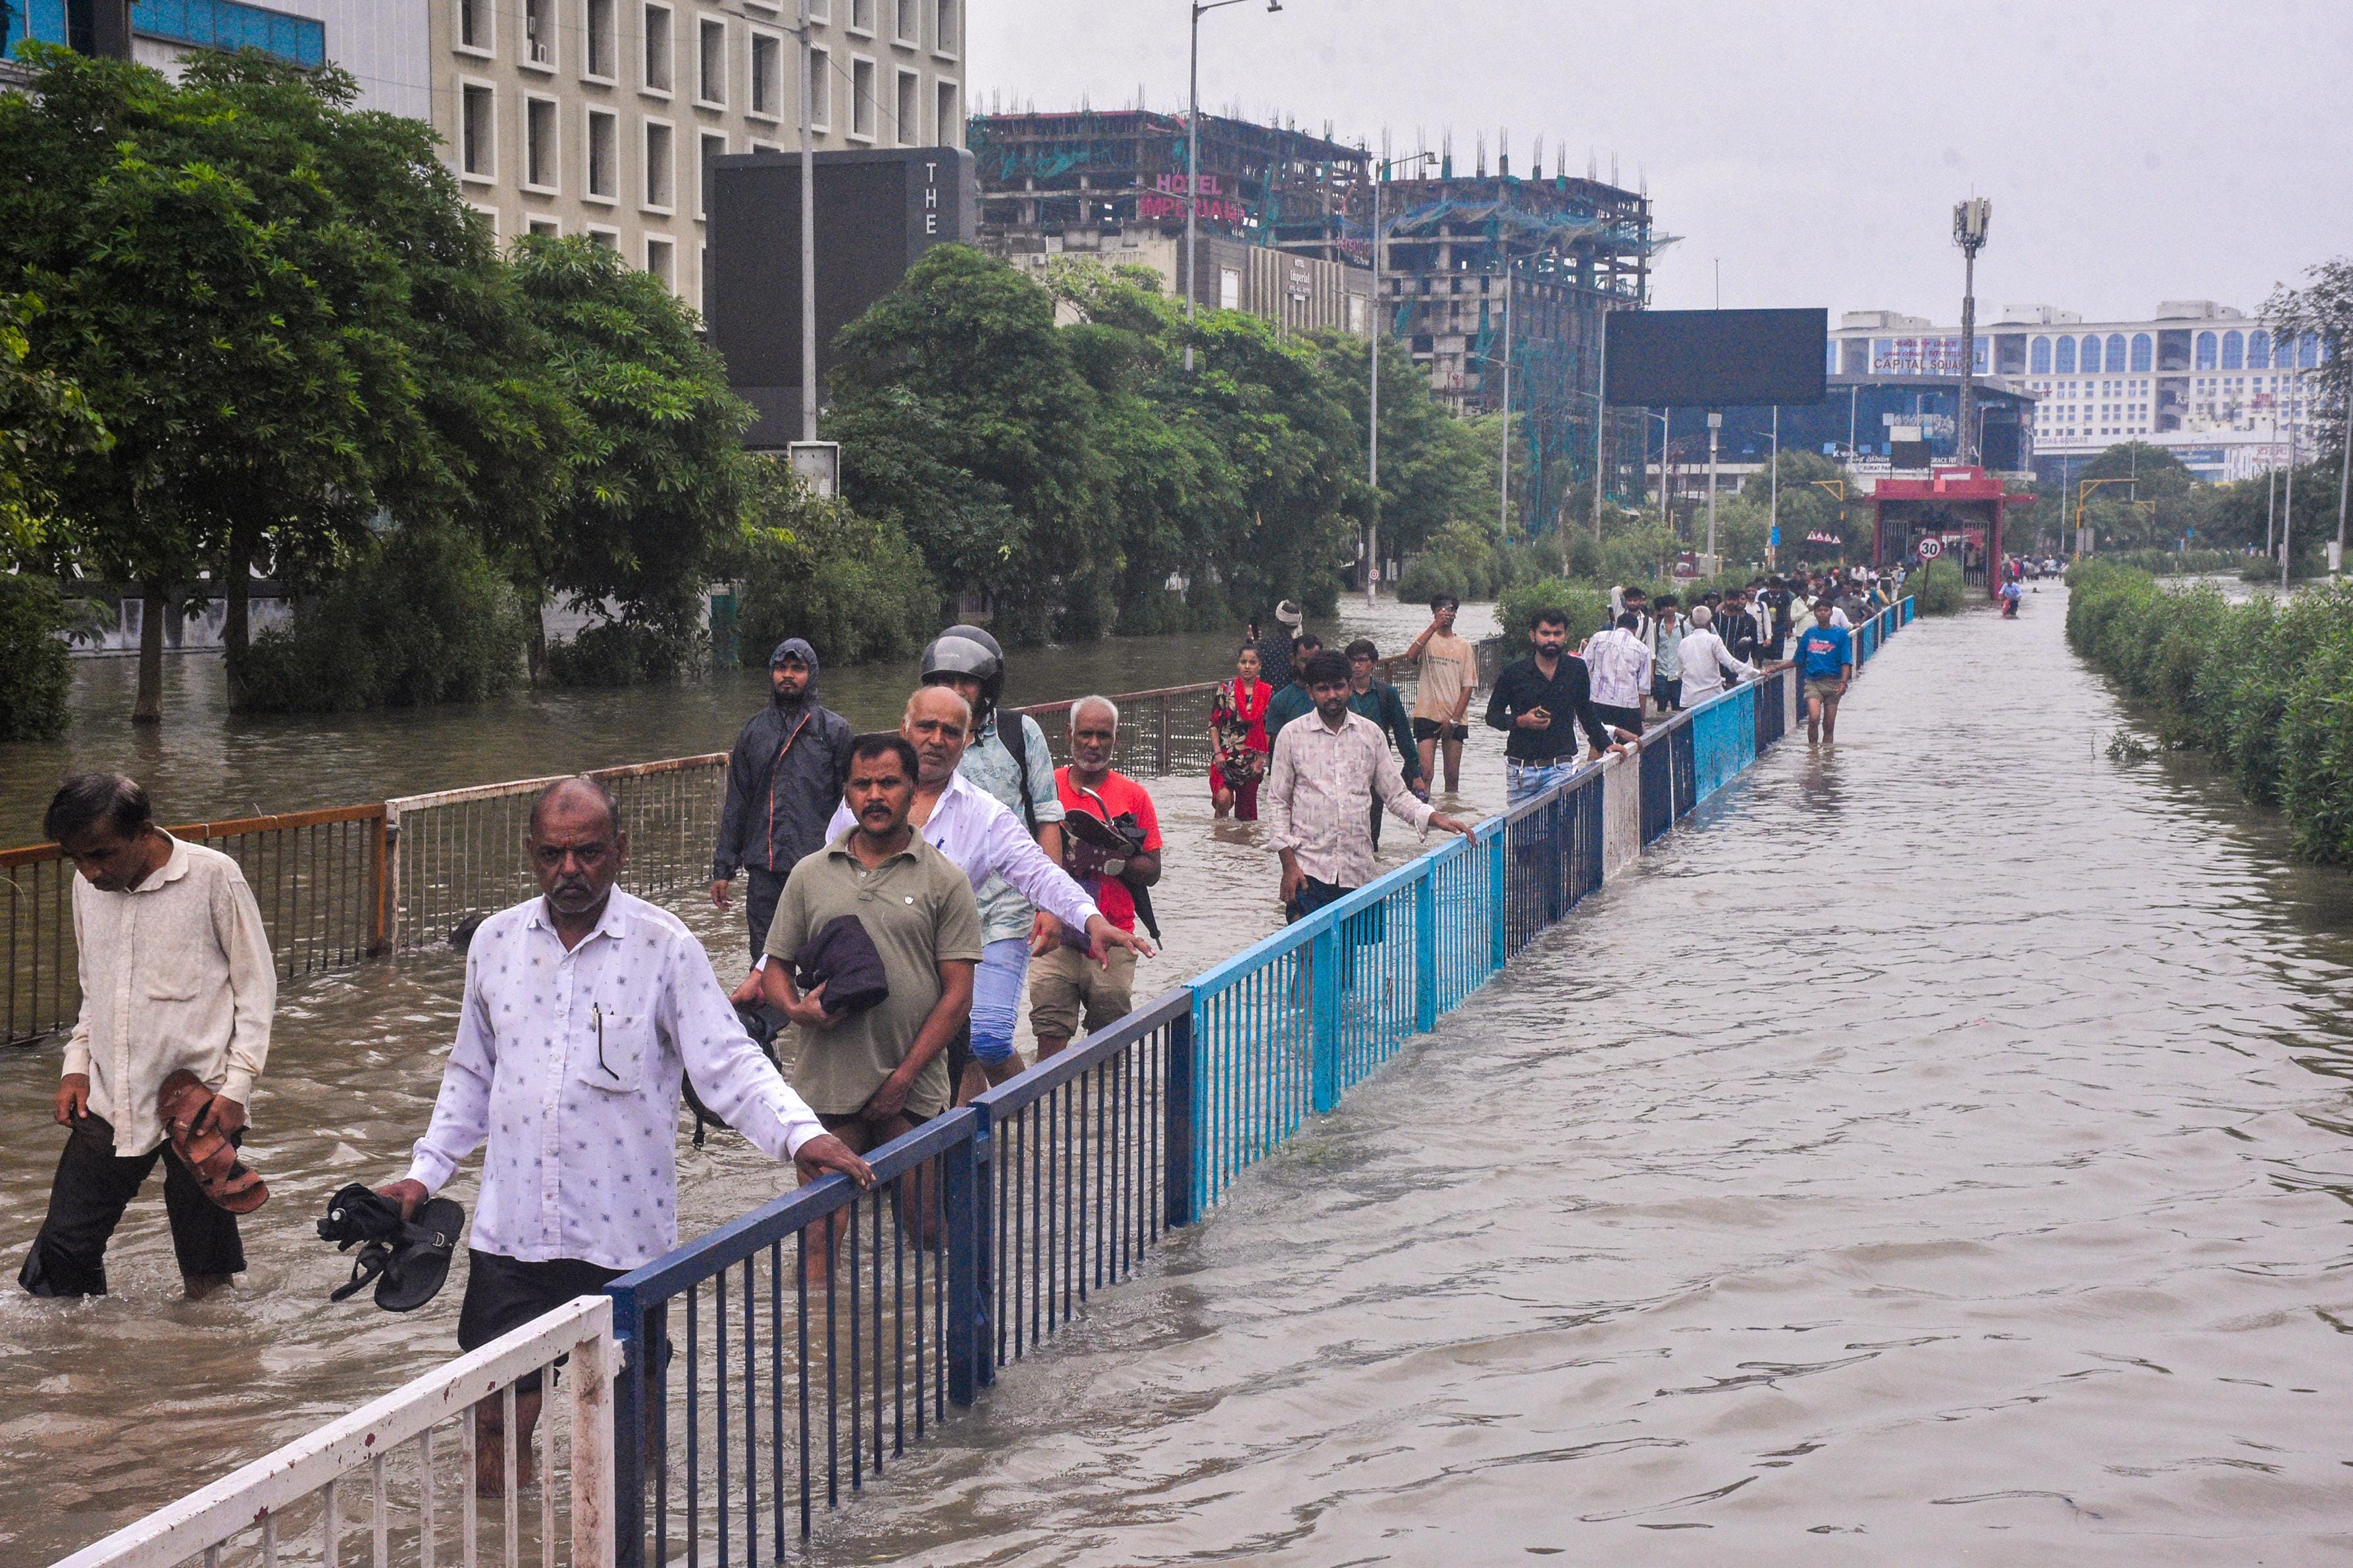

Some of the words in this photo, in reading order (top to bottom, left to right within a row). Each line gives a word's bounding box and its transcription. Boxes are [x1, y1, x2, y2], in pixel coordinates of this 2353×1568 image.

[925, 163, 937, 234] THE
[1290, 269, 1310, 285] Imperial
[1874, 359, 1926, 369] CAPITAL
[1921, 542, 1937, 555] 30
